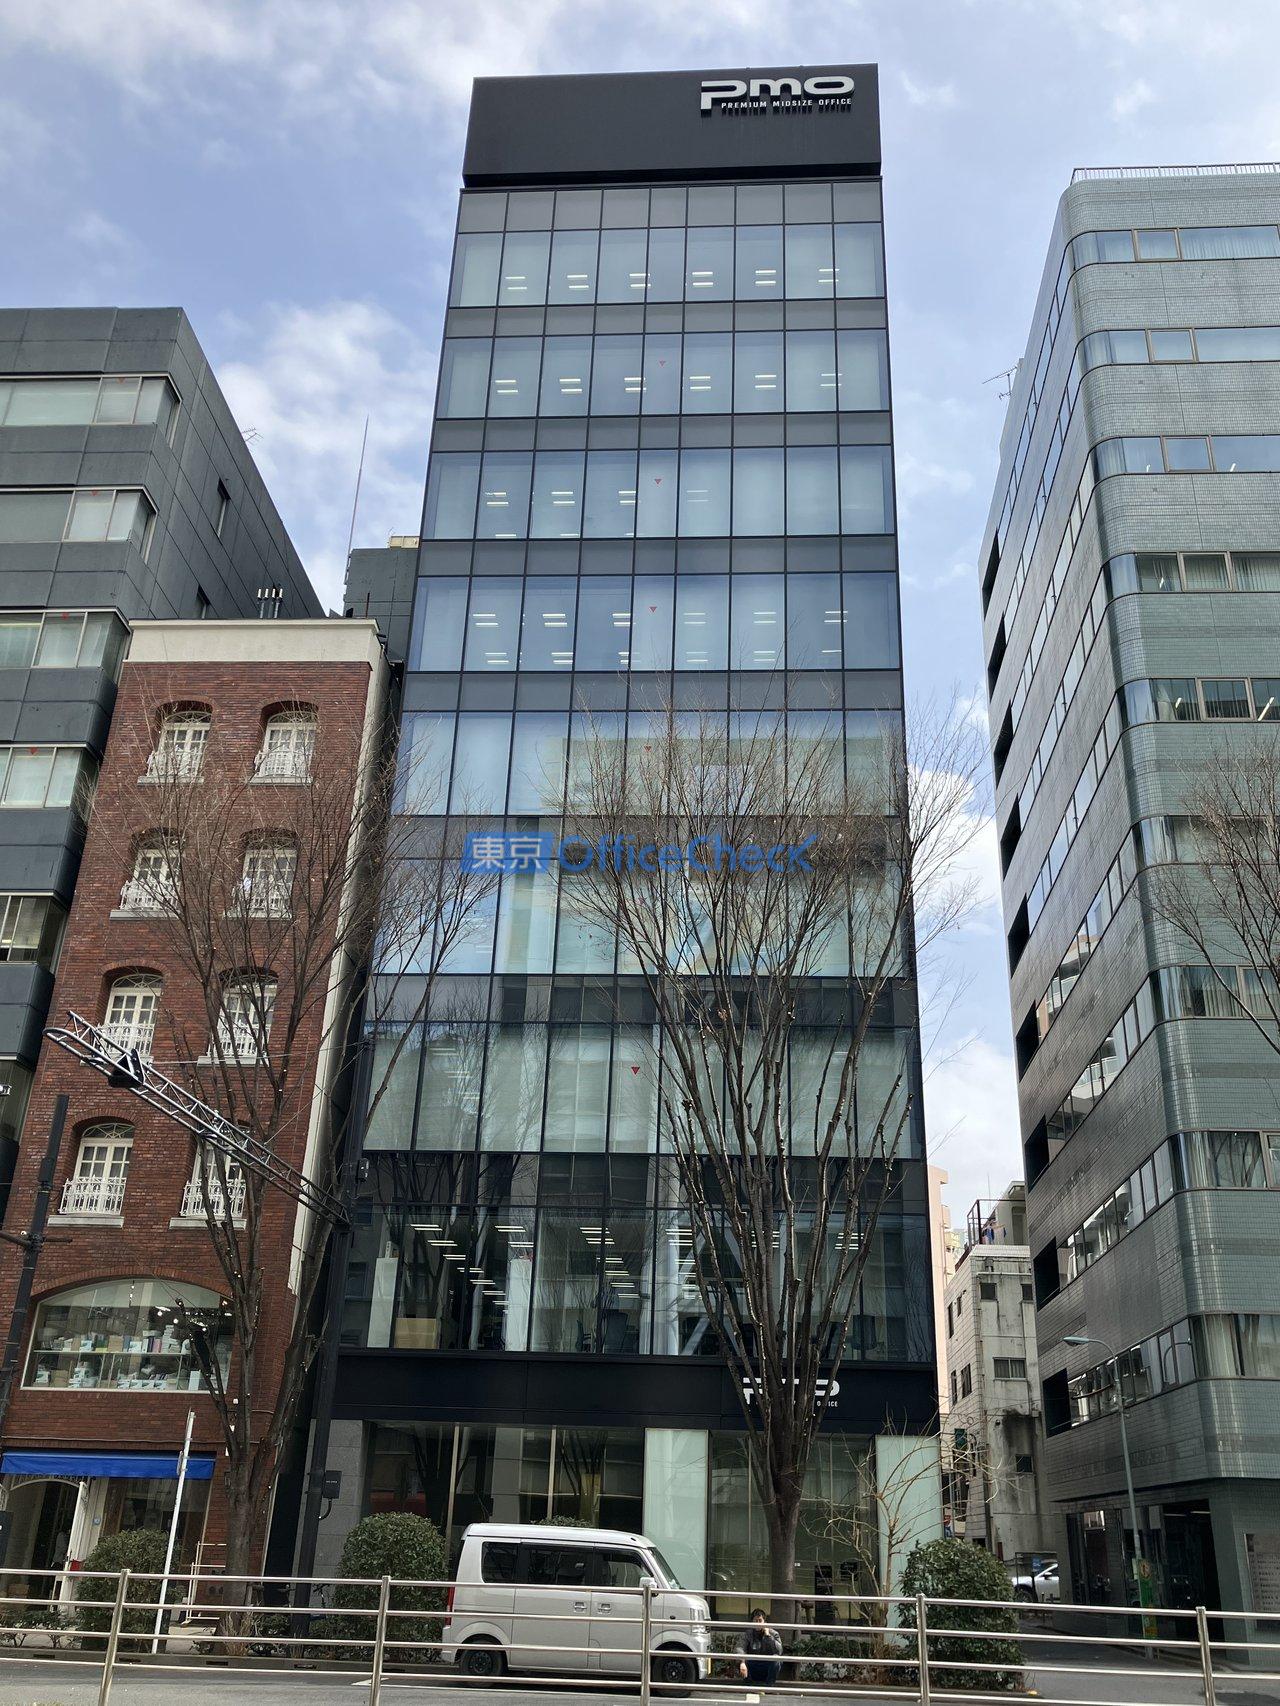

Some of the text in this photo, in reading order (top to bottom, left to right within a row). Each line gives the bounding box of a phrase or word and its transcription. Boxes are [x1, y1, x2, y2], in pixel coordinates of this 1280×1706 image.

[721, 98, 852, 109] PREMIUM MIDSIZE OFFICE
